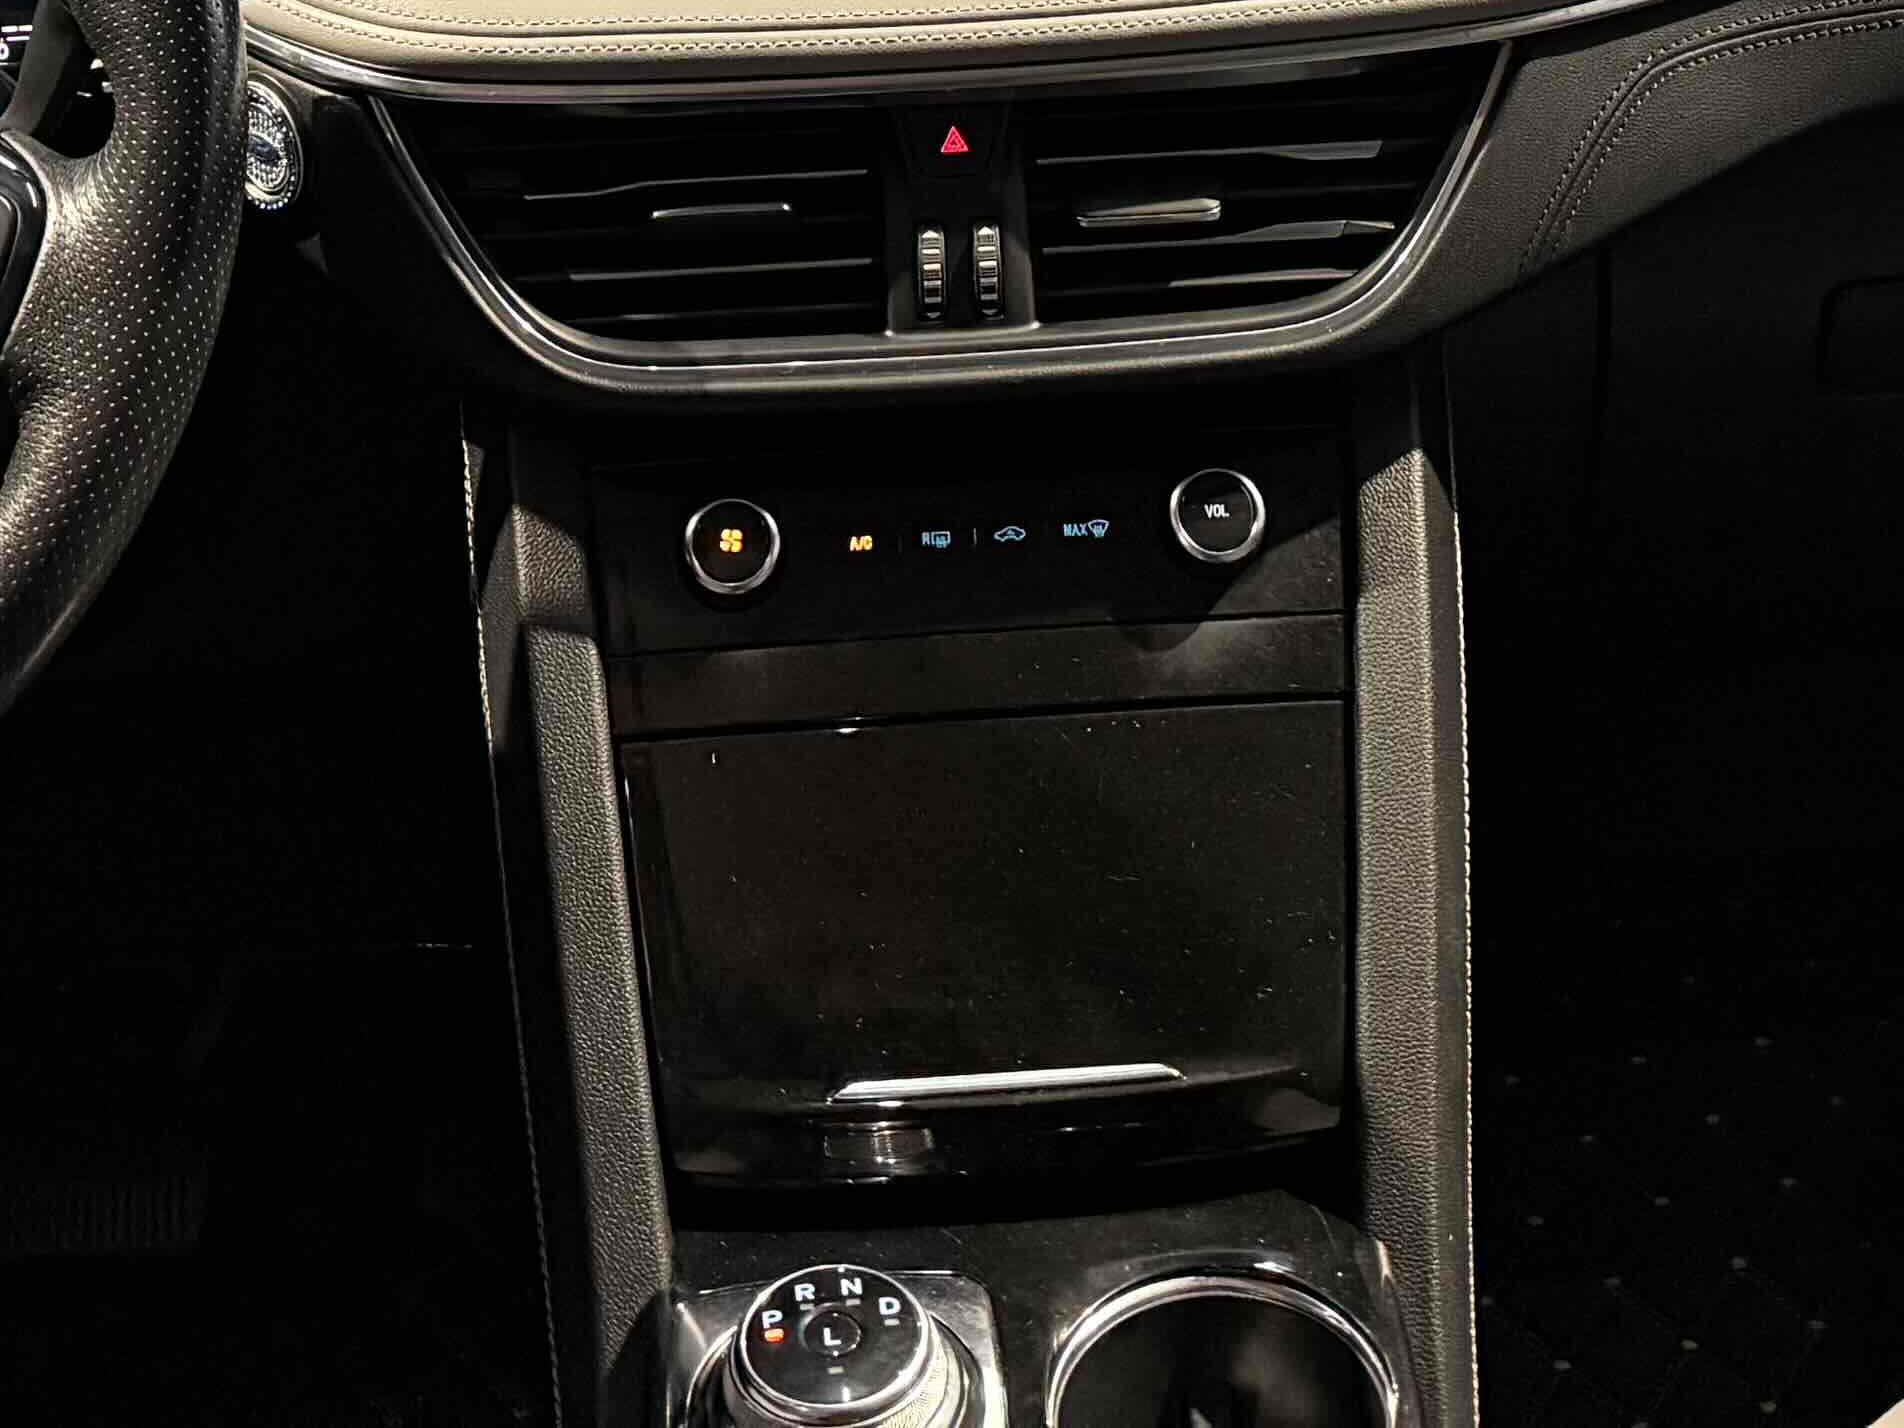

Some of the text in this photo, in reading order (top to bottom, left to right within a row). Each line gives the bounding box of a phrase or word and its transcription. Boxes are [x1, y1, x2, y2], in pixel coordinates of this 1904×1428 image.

[1203, 503, 1231, 519] VOL
[1062, 523, 1088, 537] MAX
[849, 535, 873, 552] A/C
[761, 1277, 901, 1329] P R N D
[823, 1327, 842, 1346] L
